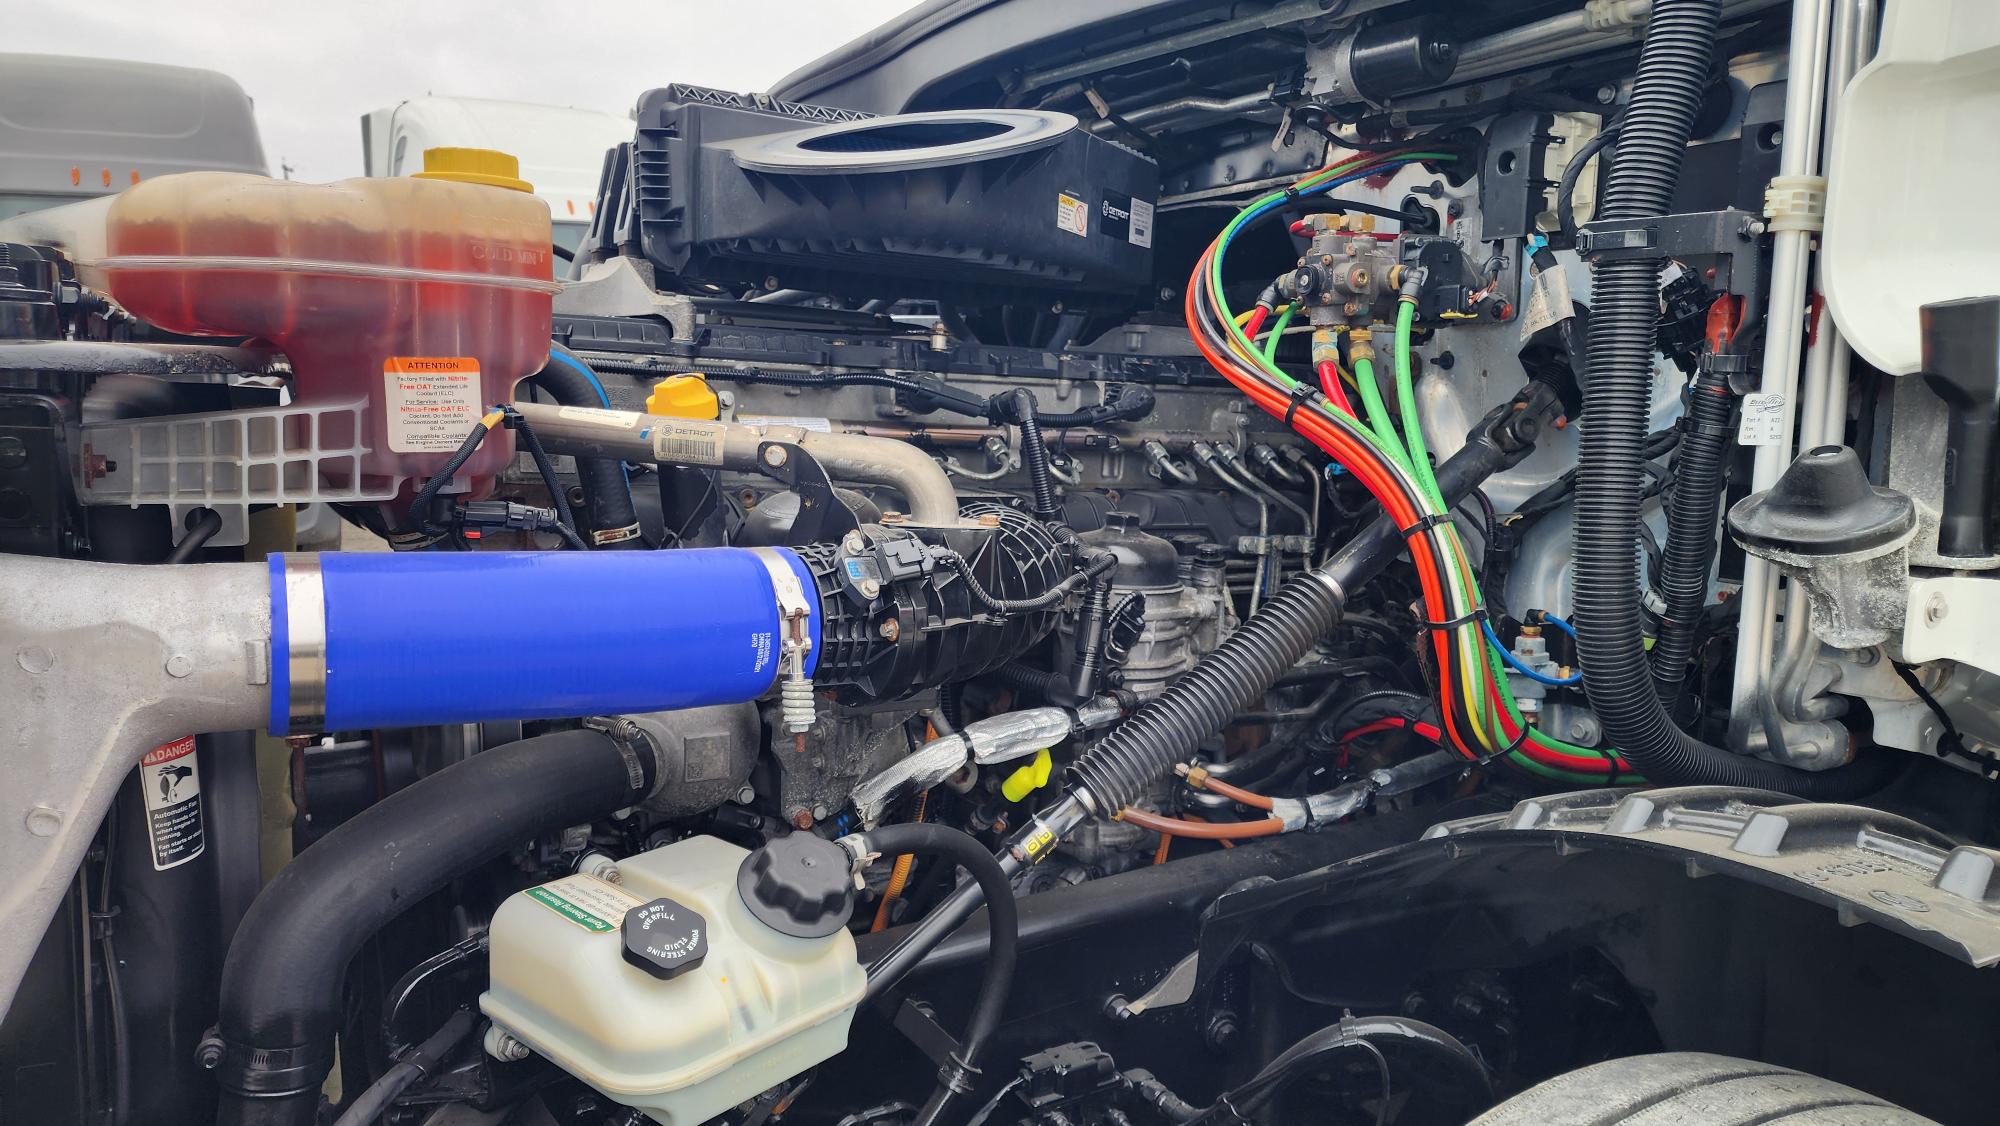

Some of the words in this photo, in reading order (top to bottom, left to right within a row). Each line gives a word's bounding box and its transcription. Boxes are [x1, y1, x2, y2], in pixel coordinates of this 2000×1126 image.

[1108, 206, 1129, 220] DETROIT
[472, 245, 513, 262] COLD
[675, 428, 716, 437] DETROIT
[156, 740, 194, 761] DANGER
[154, 805, 188, 820] Automatic
[155, 820, 172, 829] Keep
[172, 814, 188, 825] hands
[156, 826, 173, 836] when
[174, 819, 191, 831] engine
[157, 830, 182, 842] running.
[158, 843, 170, 851] Fan
[171, 838, 187, 847] starts
[159, 850, 168, 858] by
[169, 846, 185, 854] itself.
[535, 889, 562, 907] Reservoir
[560, 902, 589, 920] Steering
[638, 910, 649, 919] DO
[584, 914, 606, 930] Power
[642, 912, 675, 930] OVERFILL
[664, 937, 688, 951] FLUID
[686, 929, 699, 951] POWER
[646, 946, 686, 959] STEERING
